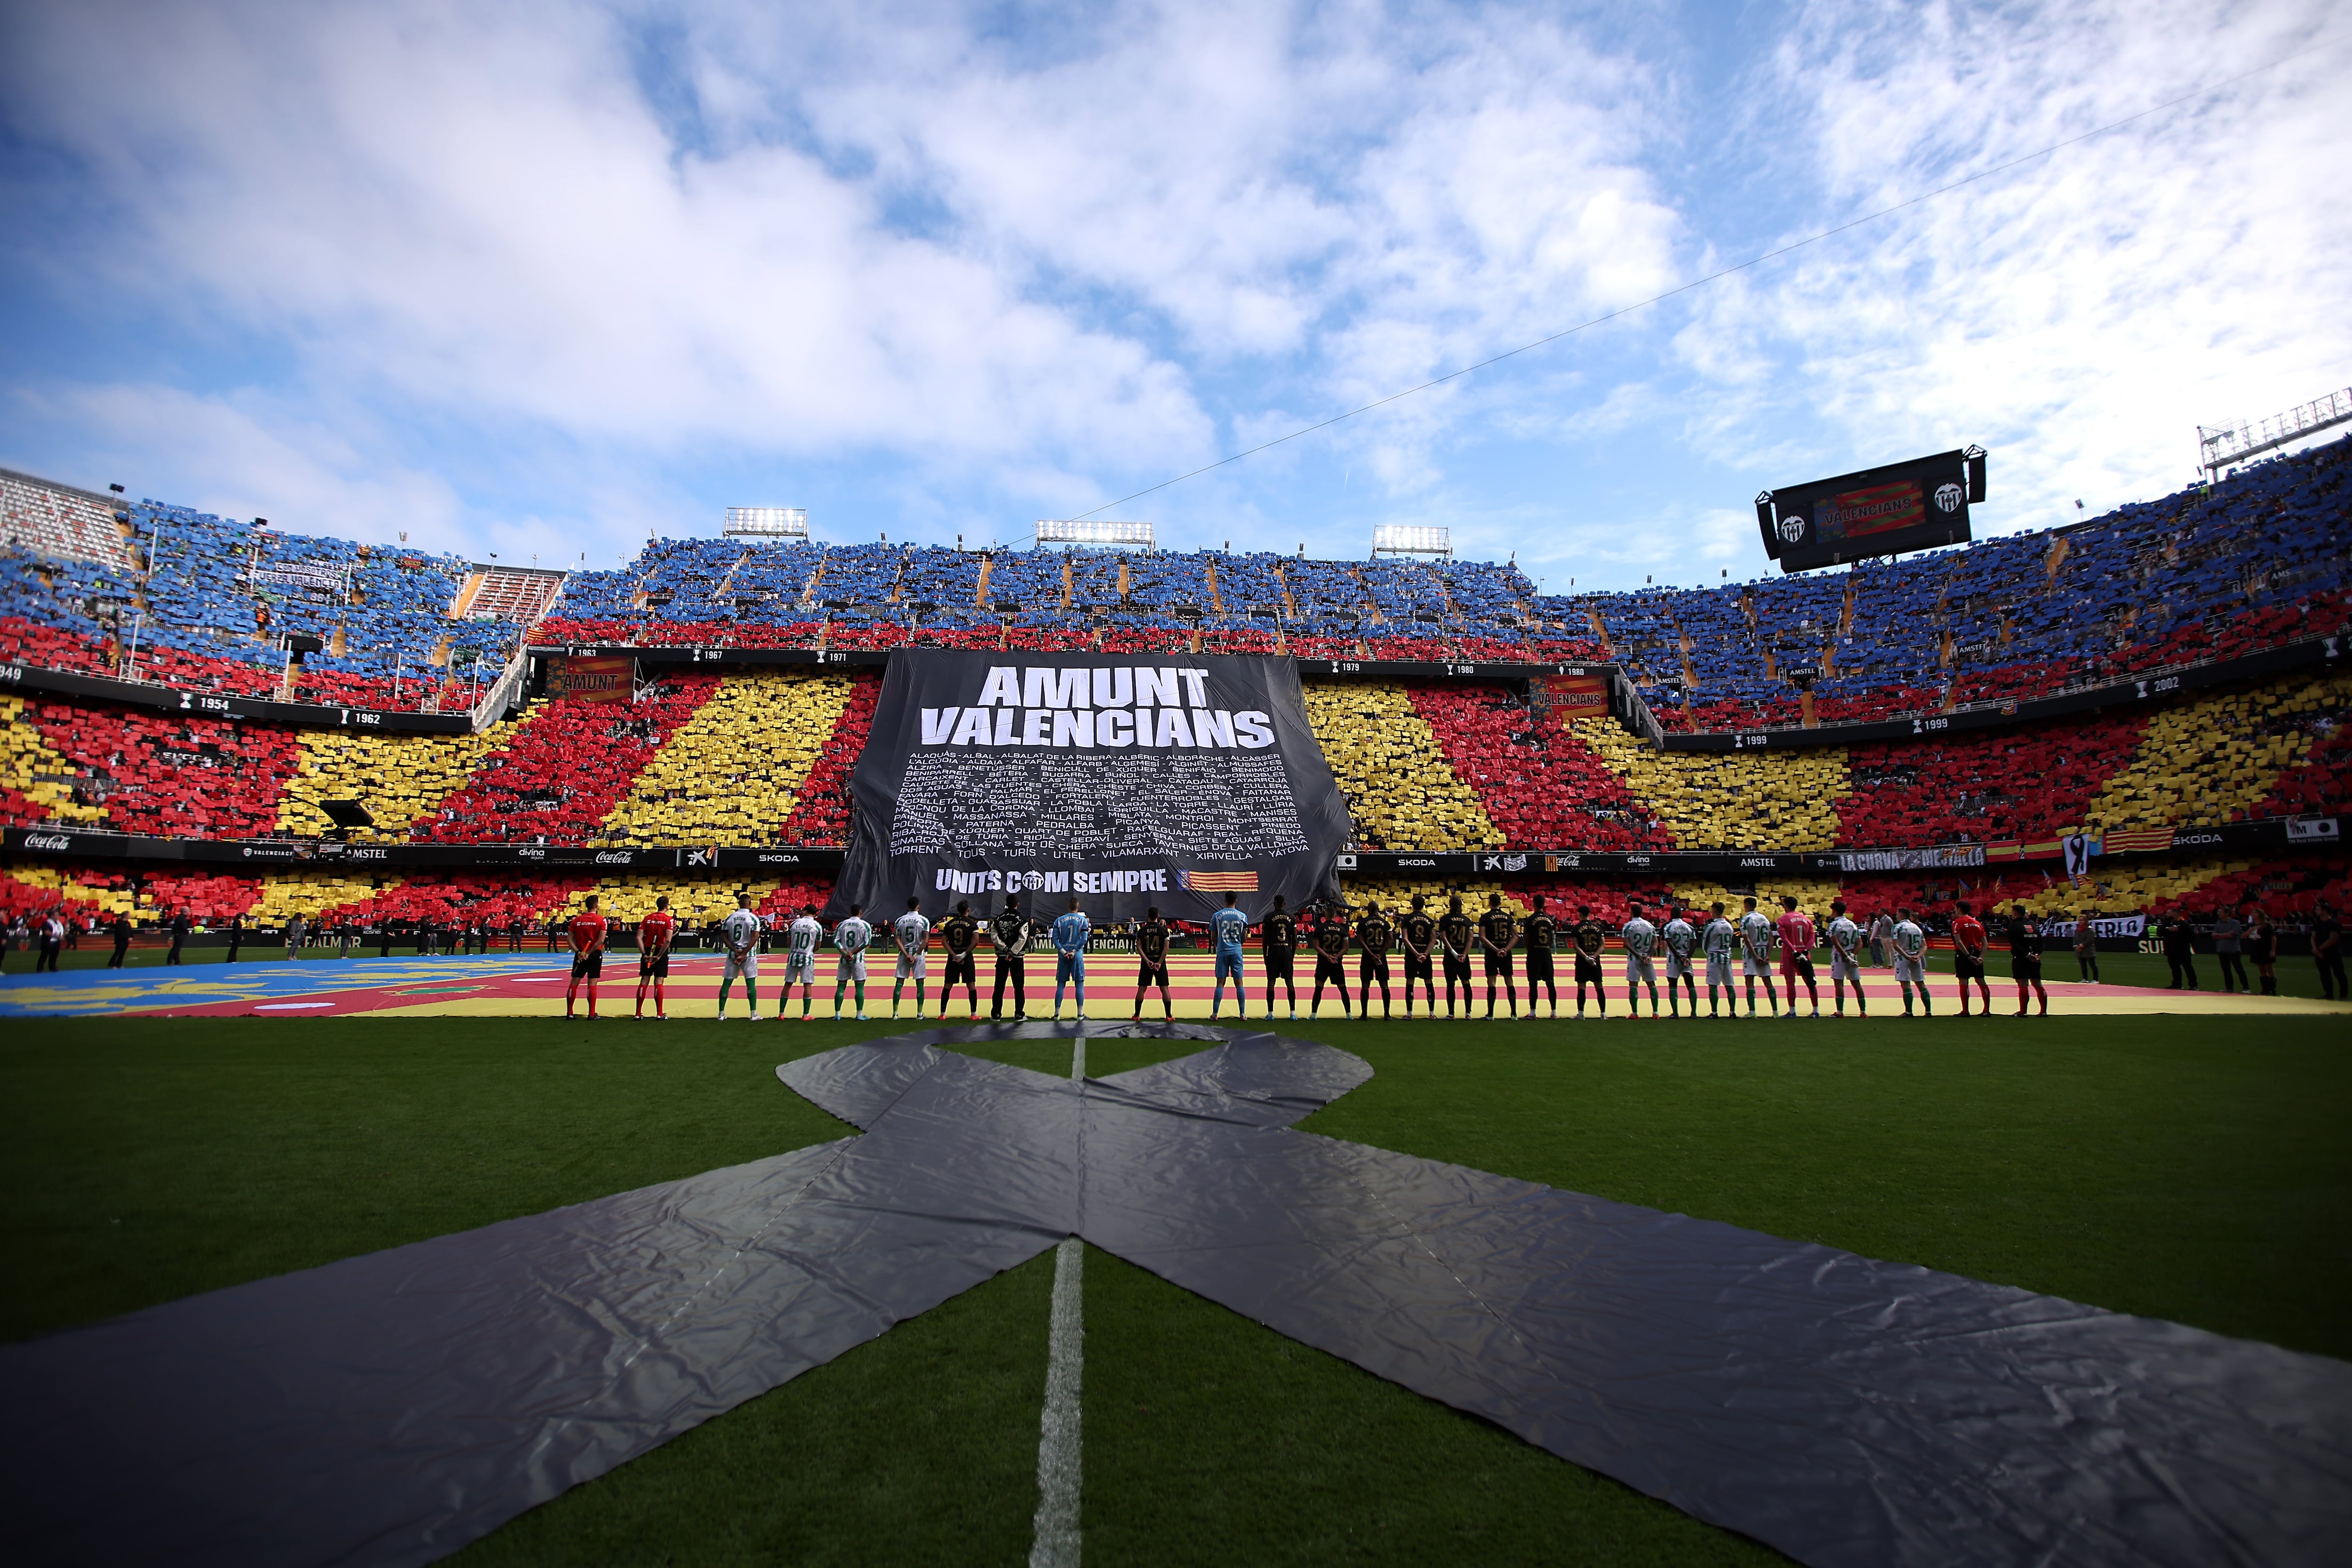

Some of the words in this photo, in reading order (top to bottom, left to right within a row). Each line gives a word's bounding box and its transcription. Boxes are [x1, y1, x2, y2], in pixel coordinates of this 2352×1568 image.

[1825, 498, 1912, 524] VALENCIANS
[705, 651, 722, 659] 1967
[830, 653, 846, 661] 1971
[1342, 663, 1359, 671] 1979
[1457, 665, 1474, 674] 1980
[562, 674, 617, 691] AMUNT
[977, 666, 1208, 708] AMUNT
[2154, 676, 2179, 692] 2002
[200, 697, 229, 710] 1954
[1538, 693, 1601, 705] VALENCIANS
[356, 713, 381, 724] 1962
[1924, 718, 1948, 730] 1999
[922, 707, 1275, 748] VALENCIANS
[1746, 735, 1767, 745] 1999
[1061, 787, 1127, 796] PERELLONET
[1107, 799, 1147, 807] LLARGA
[1182, 808, 1238, 817] MACASTRE
[1128, 824, 1203, 837] RAFELGUARAF
[1182, 822, 1240, 830] PICASSENT
[890, 836, 945, 847] SINARCAS
[1153, 838, 1208, 851] TAVERNES
[1124, 832, 1174, 842] SENYERA
[596, 851, 634, 864] Coca-Cola
[890, 845, 941, 856] TORRENT
[957, 848, 985, 858] TOUS
[1003, 846, 1036, 856] TURÍS
[1102, 847, 1179, 858] VILAMARXANT
[1268, 845, 1310, 857] YÁTOVA
[1741, 858, 1775, 867] AMSTEL
[1841, 854, 1856, 871] LA
[1857, 852, 1900, 870] CURVA
[936, 868, 1001, 894] UNITS
[1073, 868, 1168, 894] SEMPRE
[733, 924, 742, 941] 6
[905, 926, 914, 943] 5
[954, 928, 962, 946] 9
[1068, 925, 1073, 942] 1
[1221, 920, 1240, 939] 25
[1277, 923, 1286, 941] 3
[1366, 928, 1384, 946] 20
[1415, 925, 1424, 942] 8
[1449, 925, 1465, 944] 24
[1493, 922, 1508, 939] 15
[1539, 926, 1548, 944] 5
[1756, 926, 1769, 942] 16
[1797, 925, 1803, 942] 1
[795, 931, 809, 949] 10
[847, 931, 855, 947] 8
[1144, 935, 1160, 953] 14
[1323, 934, 1341, 951] 22
[1581, 934, 1597, 951] 16
[1633, 932, 1652, 949] 24
[1673, 933, 1690, 949] 23
[1719, 933, 1731, 949] 19
[1908, 934, 1921, 950] 15
